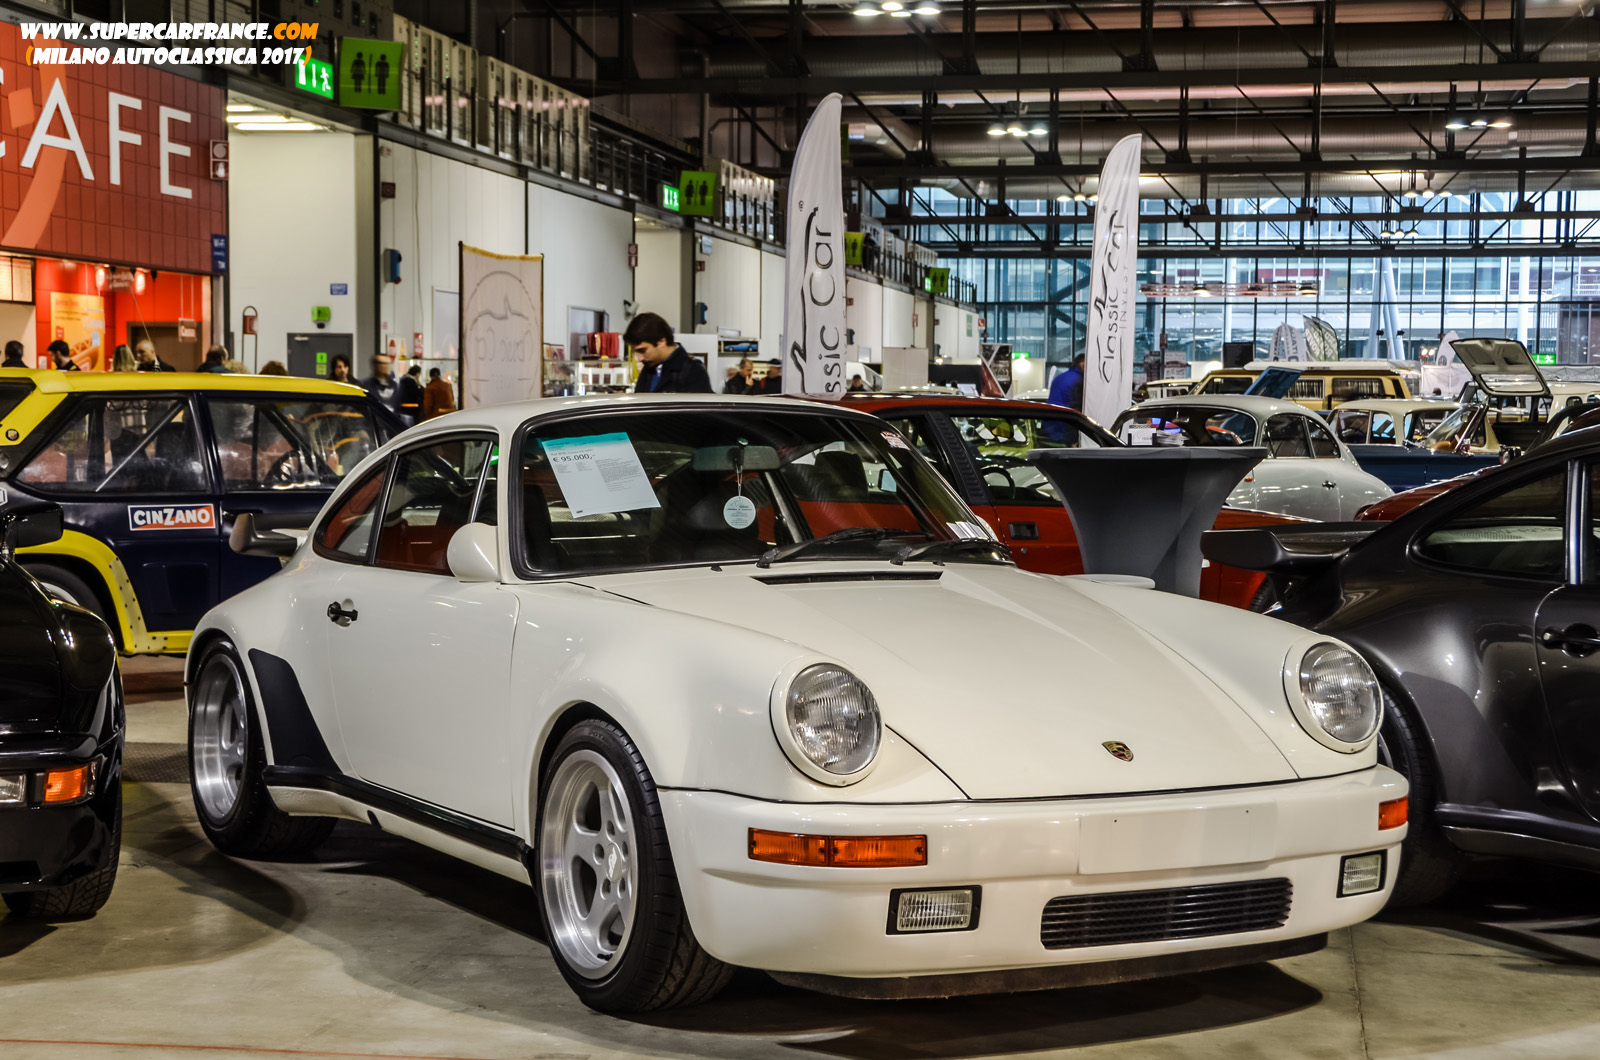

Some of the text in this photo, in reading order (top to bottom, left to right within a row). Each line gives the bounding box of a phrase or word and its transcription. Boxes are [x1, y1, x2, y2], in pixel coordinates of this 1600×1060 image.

[0, 66, 192, 199] AFE
[809, 225, 836, 307] Car
[133, 508, 211, 526] CINZANO
